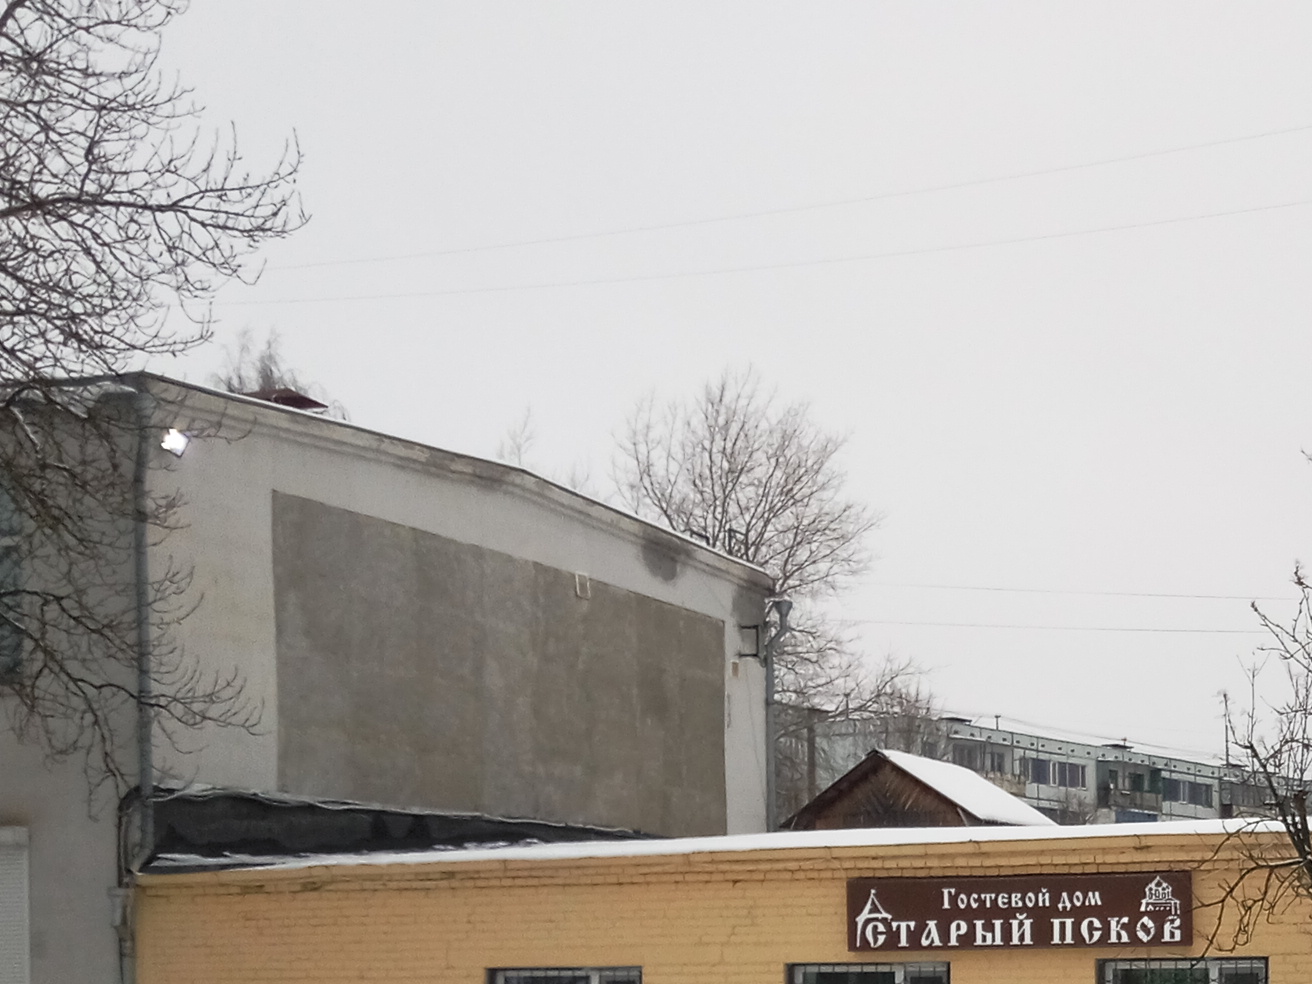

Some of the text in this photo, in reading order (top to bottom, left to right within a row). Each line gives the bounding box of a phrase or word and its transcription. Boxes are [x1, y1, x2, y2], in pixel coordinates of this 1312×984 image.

[942, 887, 1102, 911] Гостевой дом
[865, 912, 1182, 948] СТАРЫЙ ПСКОВ
